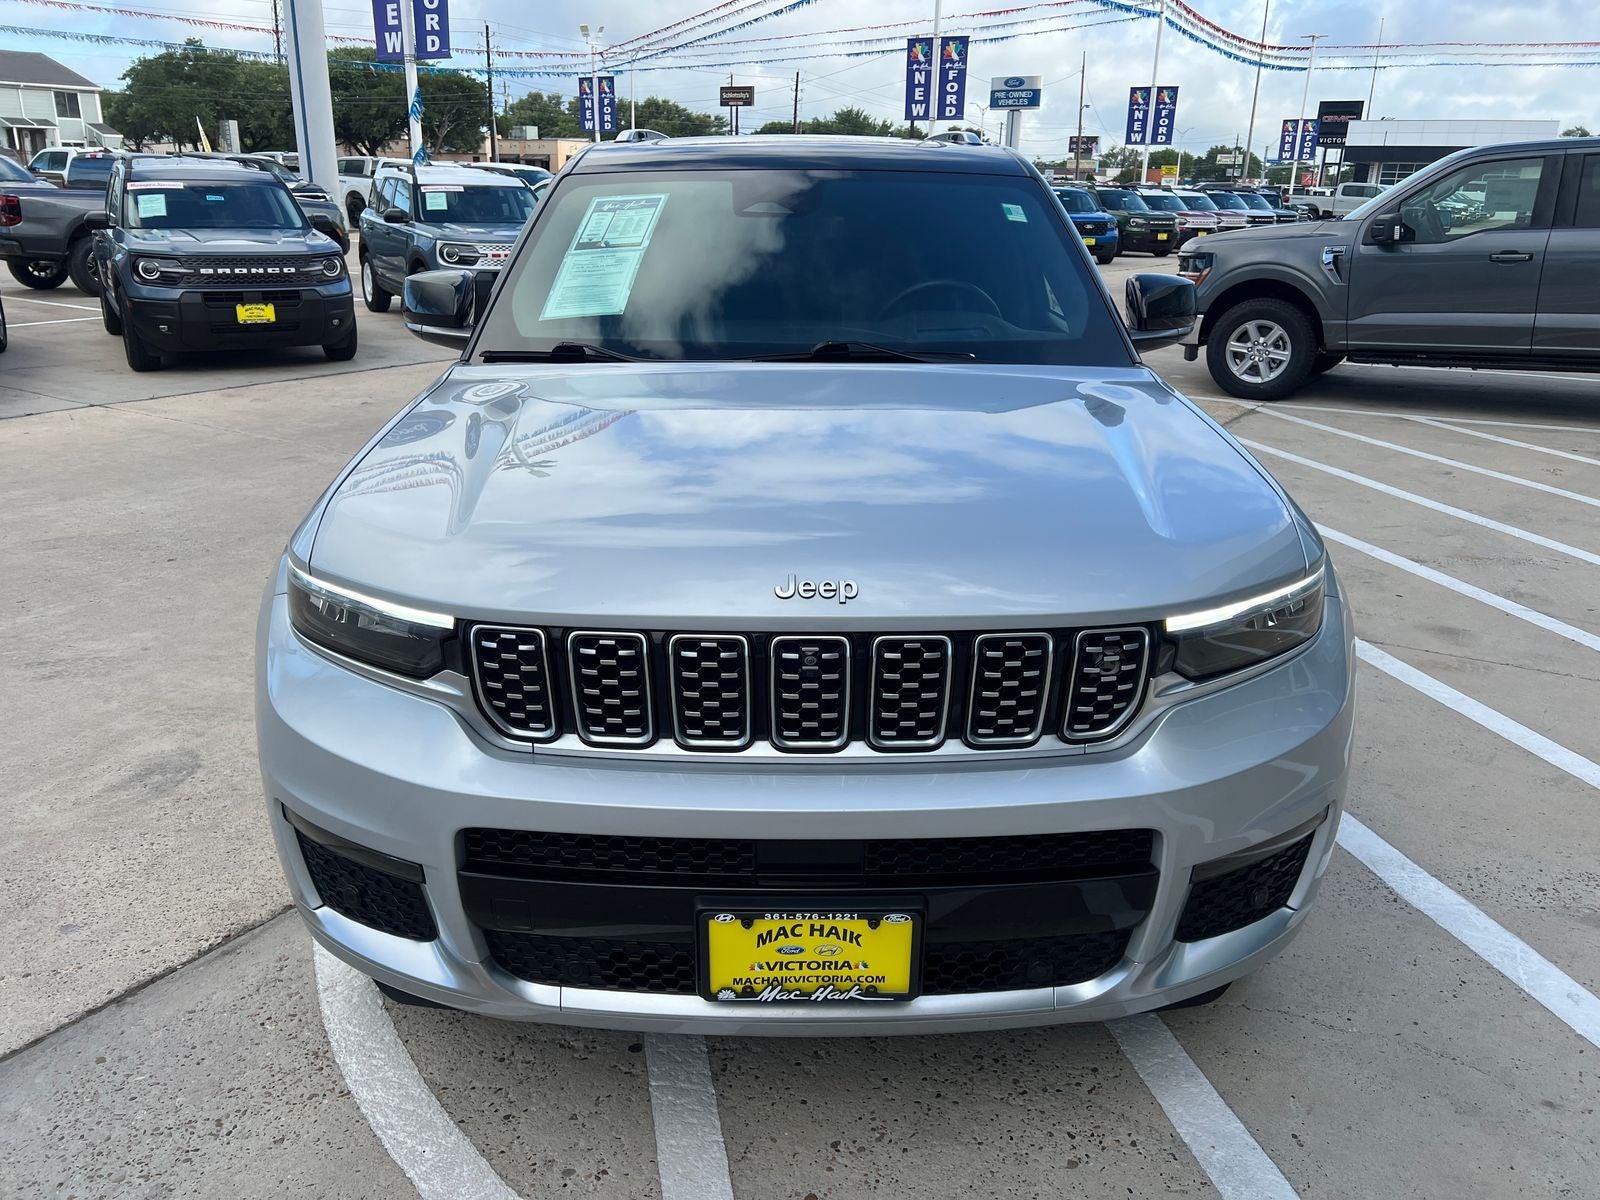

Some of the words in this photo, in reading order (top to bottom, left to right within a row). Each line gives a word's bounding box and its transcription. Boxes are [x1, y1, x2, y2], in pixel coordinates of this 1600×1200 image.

[911, 71, 926, 117] NEW
[944, 70, 959, 117] FORD
[994, 90, 1034, 98] PRE-OWNED
[998, 98, 1029, 106] VEHICLES
[584, 99, 594, 130] NEW
[603, 98, 612, 130] FORD
[1130, 110, 1144, 142] NEW
[1156, 109, 1169, 143] FORD
[1282, 135, 1292, 159] NEW
[1302, 135, 1312, 159] FORD
[774, 573, 859, 605] Jeep
[764, 913, 859, 921] 361-576-1221
[756, 924, 803, 949] MAC
[809, 923, 863, 948] HAIK
[765, 960, 853, 972] VICTORIA
[732, 975, 886, 986] MACHAIKVICTORIA.COM
[755, 985, 806, 1002] Mac
[809, 985, 866, 1002] Haik
